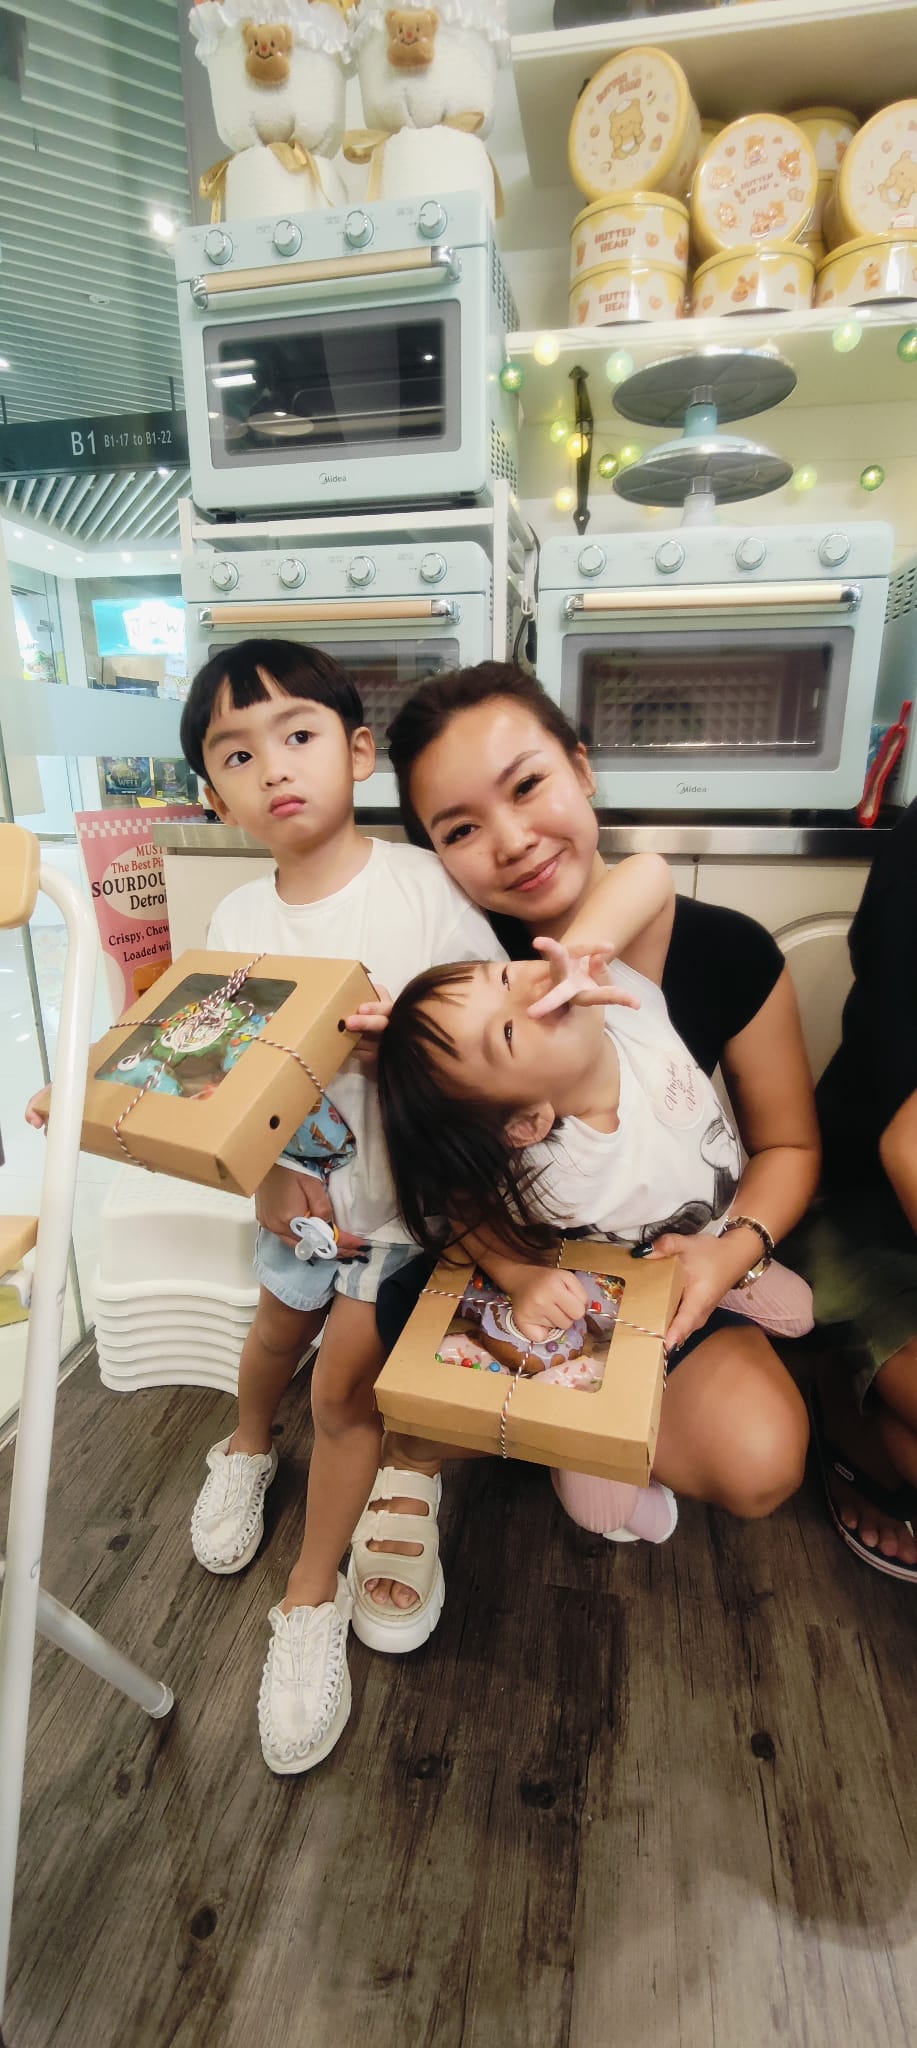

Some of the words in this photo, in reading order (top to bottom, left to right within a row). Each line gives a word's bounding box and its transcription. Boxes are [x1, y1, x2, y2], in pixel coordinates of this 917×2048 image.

[595, 227, 636, 244] BUTTER
[600, 239, 628, 253] BEAR
[71, 430, 96, 456] B1
[104, 433, 129, 448] B1-17
[133, 434, 143, 446] to
[146, 430, 172, 445] B1-22
[321, 474, 347, 484] Midea
[679, 784, 707, 793] Midea
[111, 861, 130, 874] The
[131, 859, 151, 871] Best
[108, 931, 145, 946] Crispy,
[123, 944, 157, 962] Loaded
